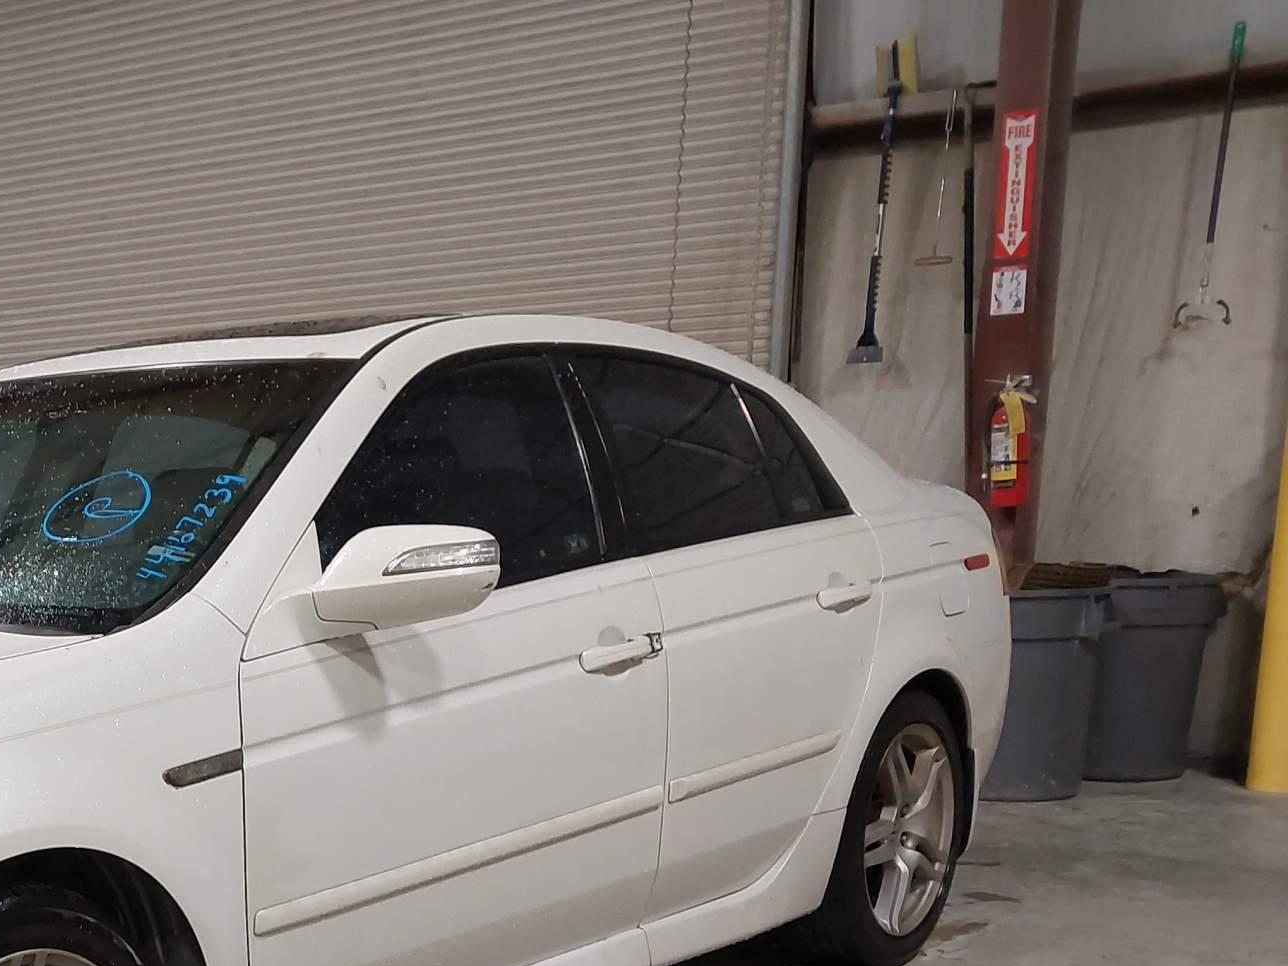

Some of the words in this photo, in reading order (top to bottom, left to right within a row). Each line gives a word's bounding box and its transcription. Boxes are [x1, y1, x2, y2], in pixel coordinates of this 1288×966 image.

[1007, 124, 1033, 140] FIRE
[1007, 145, 1021, 246] EXTINGUISHER
[136, 473, 248, 580] 44167239
